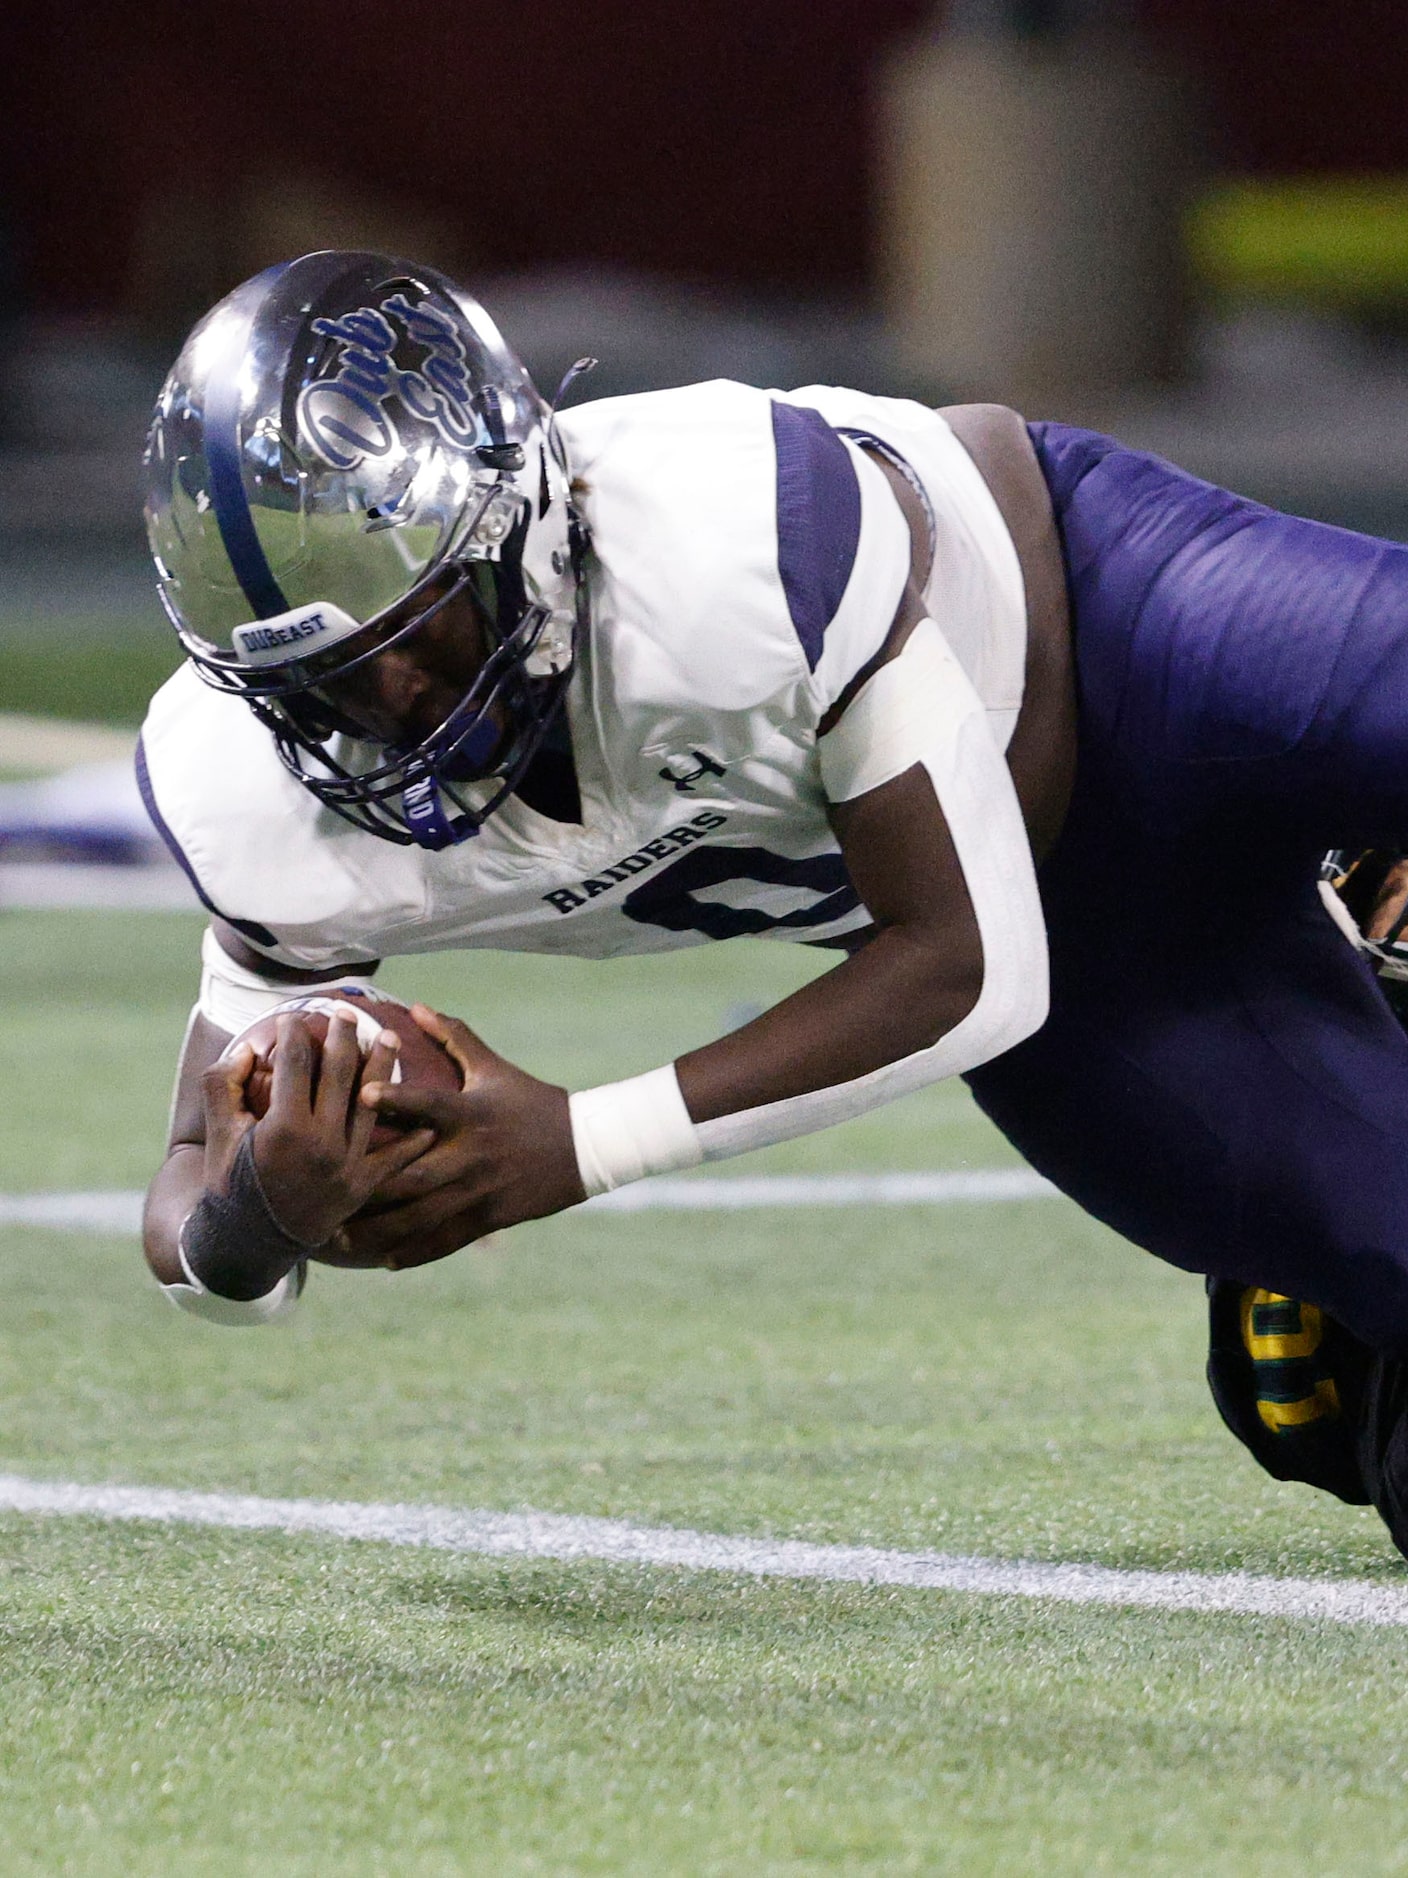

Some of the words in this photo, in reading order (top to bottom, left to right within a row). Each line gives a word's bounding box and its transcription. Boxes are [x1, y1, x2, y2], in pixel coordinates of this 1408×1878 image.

[297, 308, 398, 468] Dub
[381, 294, 478, 449] East
[542, 812, 728, 914] RAIDERS
